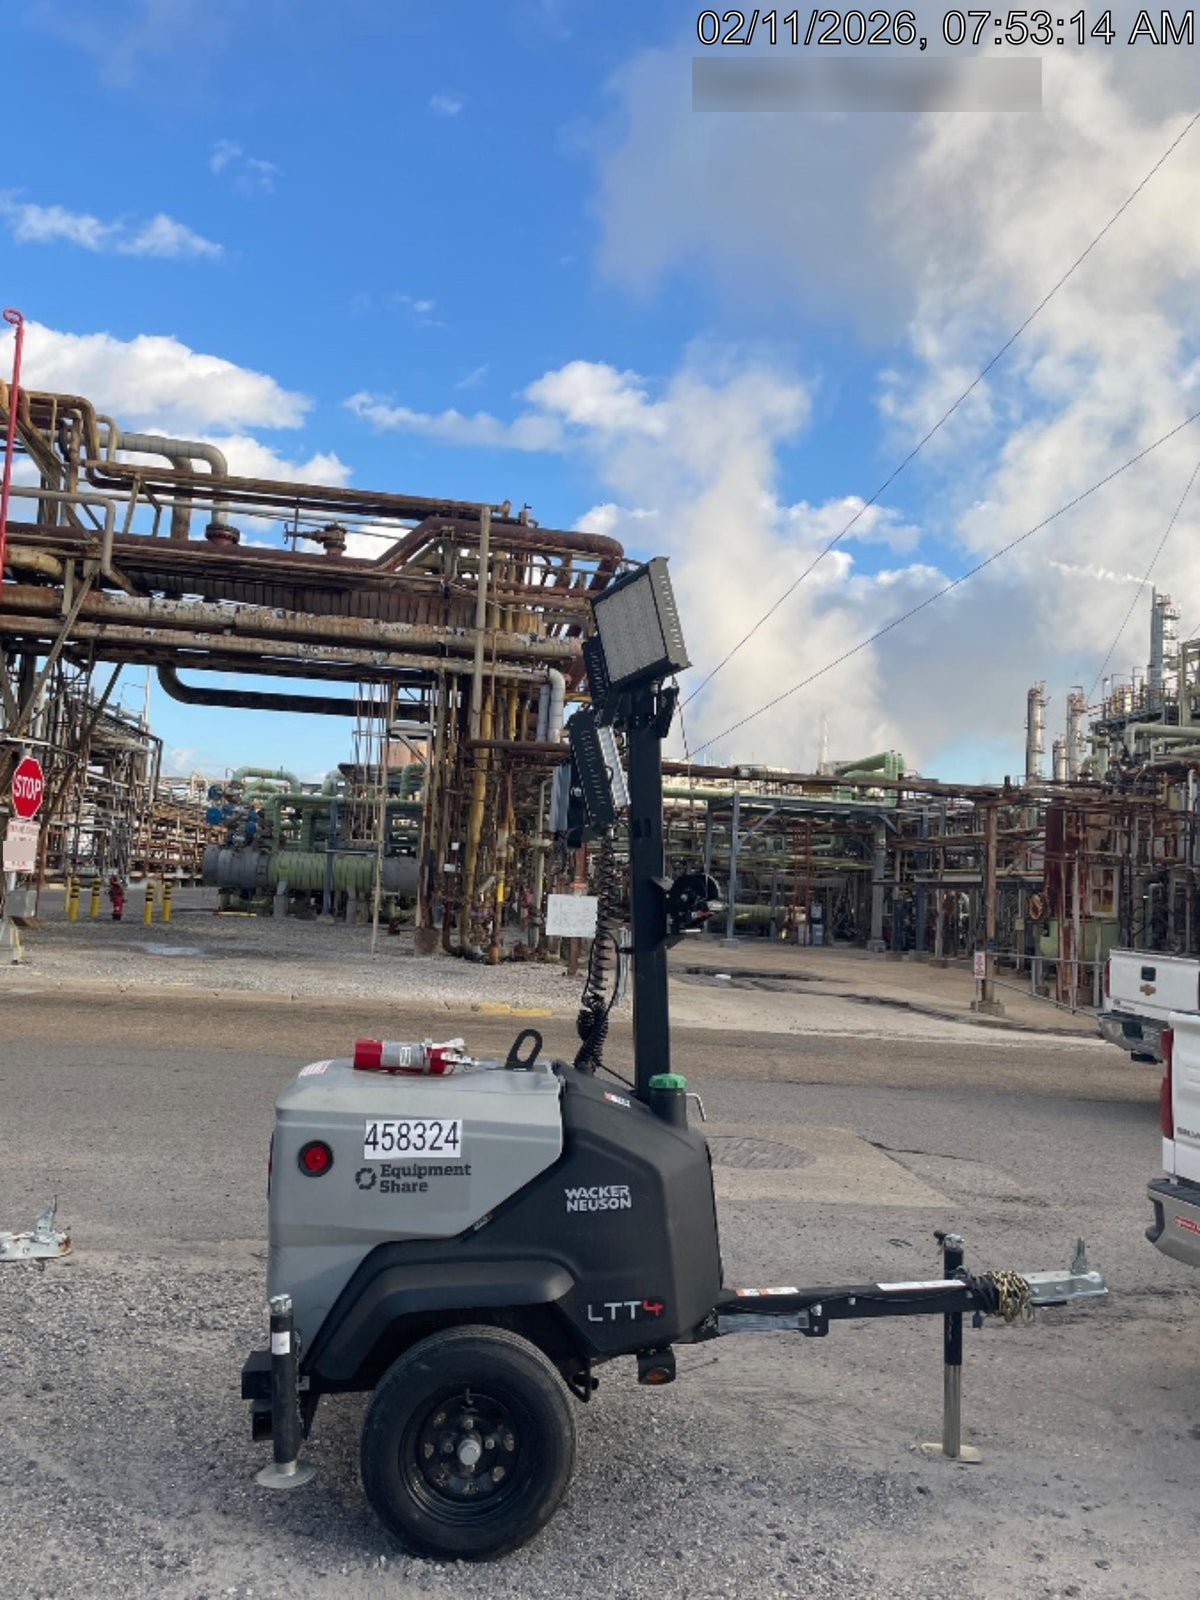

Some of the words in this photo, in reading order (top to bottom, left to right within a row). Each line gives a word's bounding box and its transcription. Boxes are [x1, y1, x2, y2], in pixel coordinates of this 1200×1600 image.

[14, 774, 41, 801] STOP
[364, 1121, 459, 1151] 458324
[379, 1163, 472, 1179] Equipment
[379, 1180, 428, 1193] Share
[564, 1185, 630, 1199] WACKER
[566, 1198, 632, 1212] NEUSON
[587, 1300, 664, 1322] LTT4
